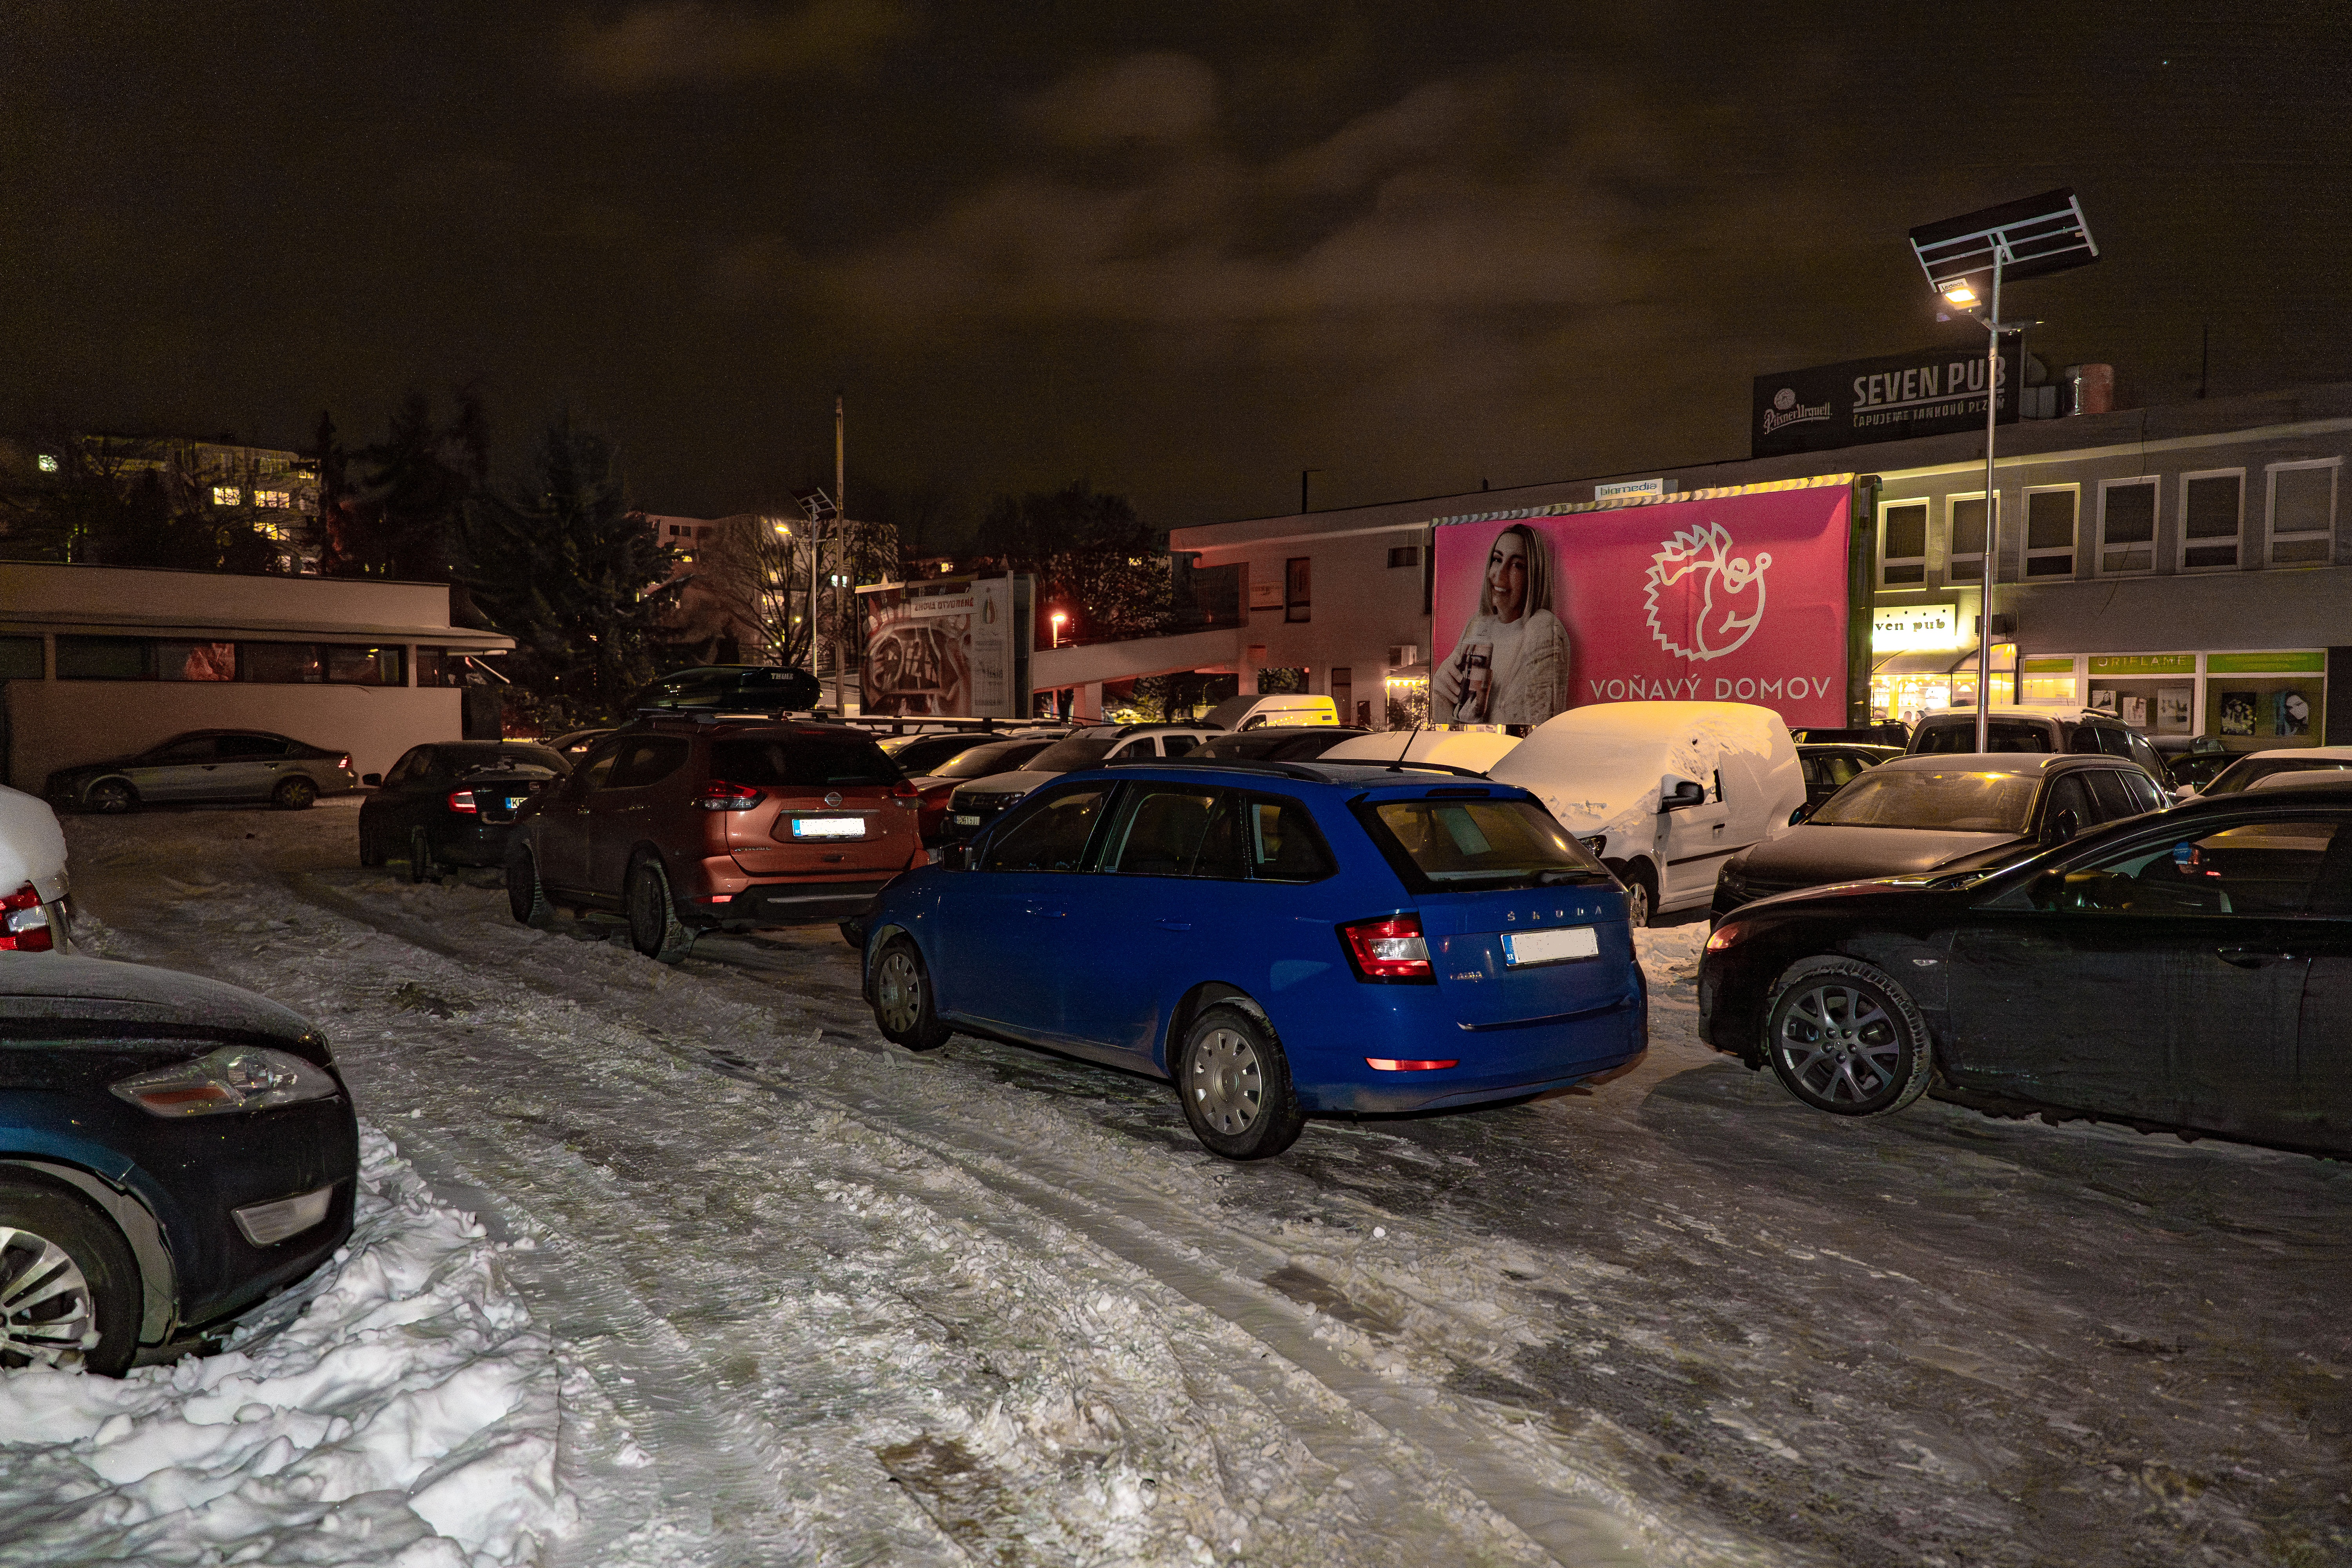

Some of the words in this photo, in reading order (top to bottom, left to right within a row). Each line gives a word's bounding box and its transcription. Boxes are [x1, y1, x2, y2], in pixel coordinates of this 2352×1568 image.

[1853, 365, 1938, 407] SEVEN
[1948, 356, 2005, 394] PUB
[1764, 409, 1797, 434] Pilsner
[1797, 402, 1830, 422] Urquell
[1913, 619, 1945, 632] pub
[2098, 655, 2186, 666] ORIFLAME
[1590, 673, 1701, 699] VOŇAVÝ
[1715, 677, 1830, 699] DOMOV
